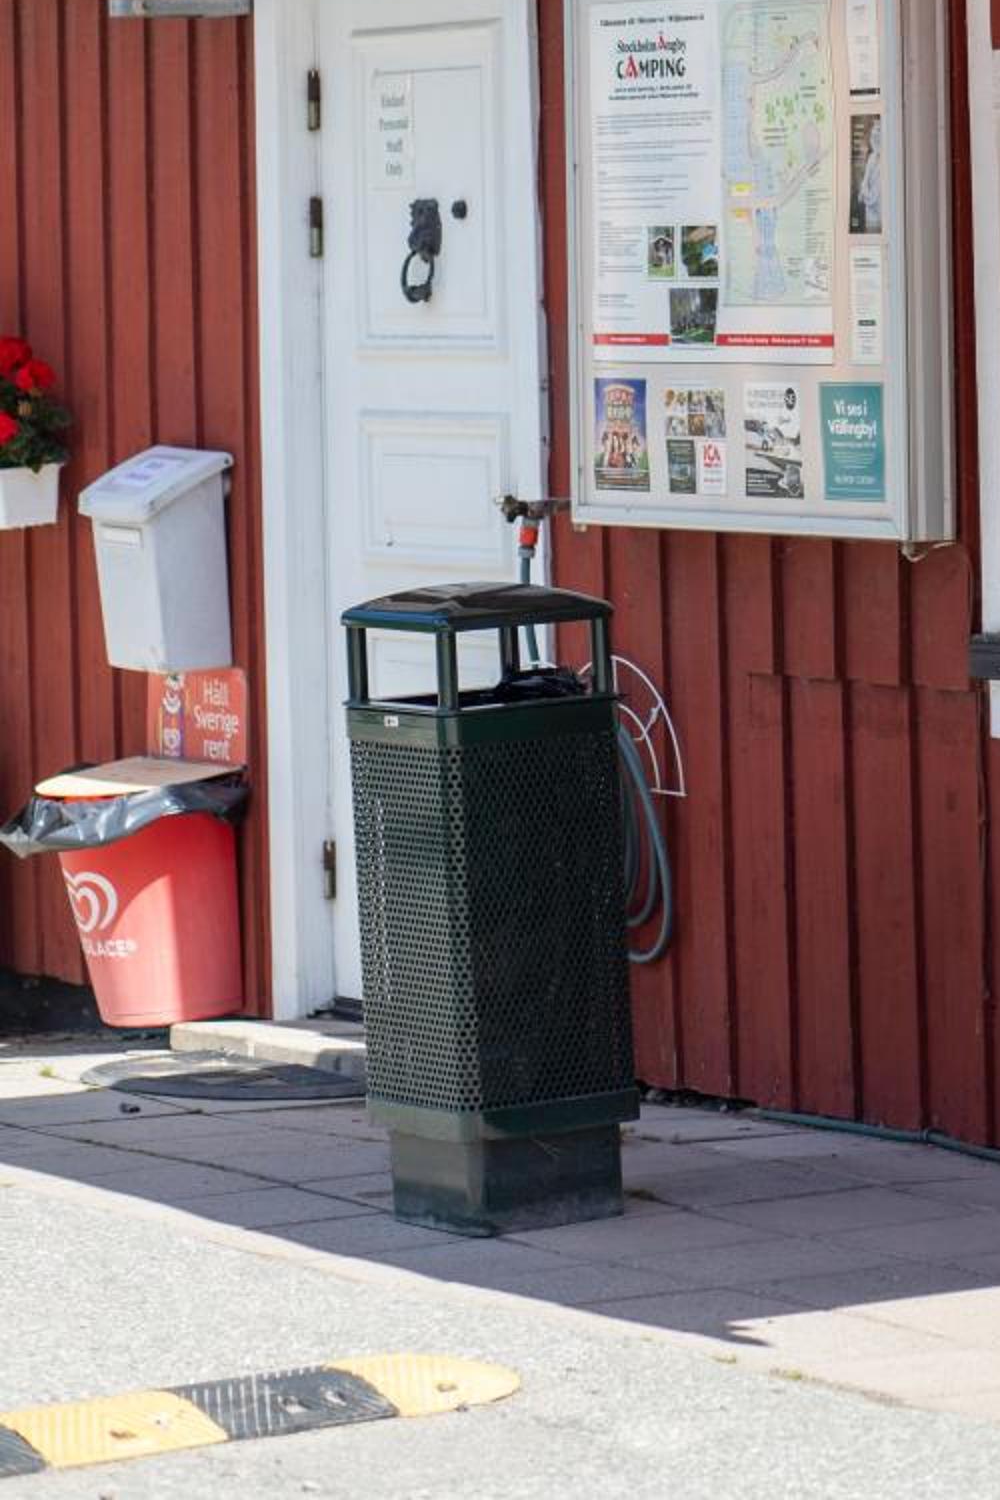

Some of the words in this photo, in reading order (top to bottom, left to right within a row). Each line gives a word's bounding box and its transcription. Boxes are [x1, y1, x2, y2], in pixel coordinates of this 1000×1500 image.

[617, 54, 688, 81] CAMPING
[203, 678, 229, 707] Håll
[193, 704, 240, 740] Sverige
[203, 739, 231, 761] rent
